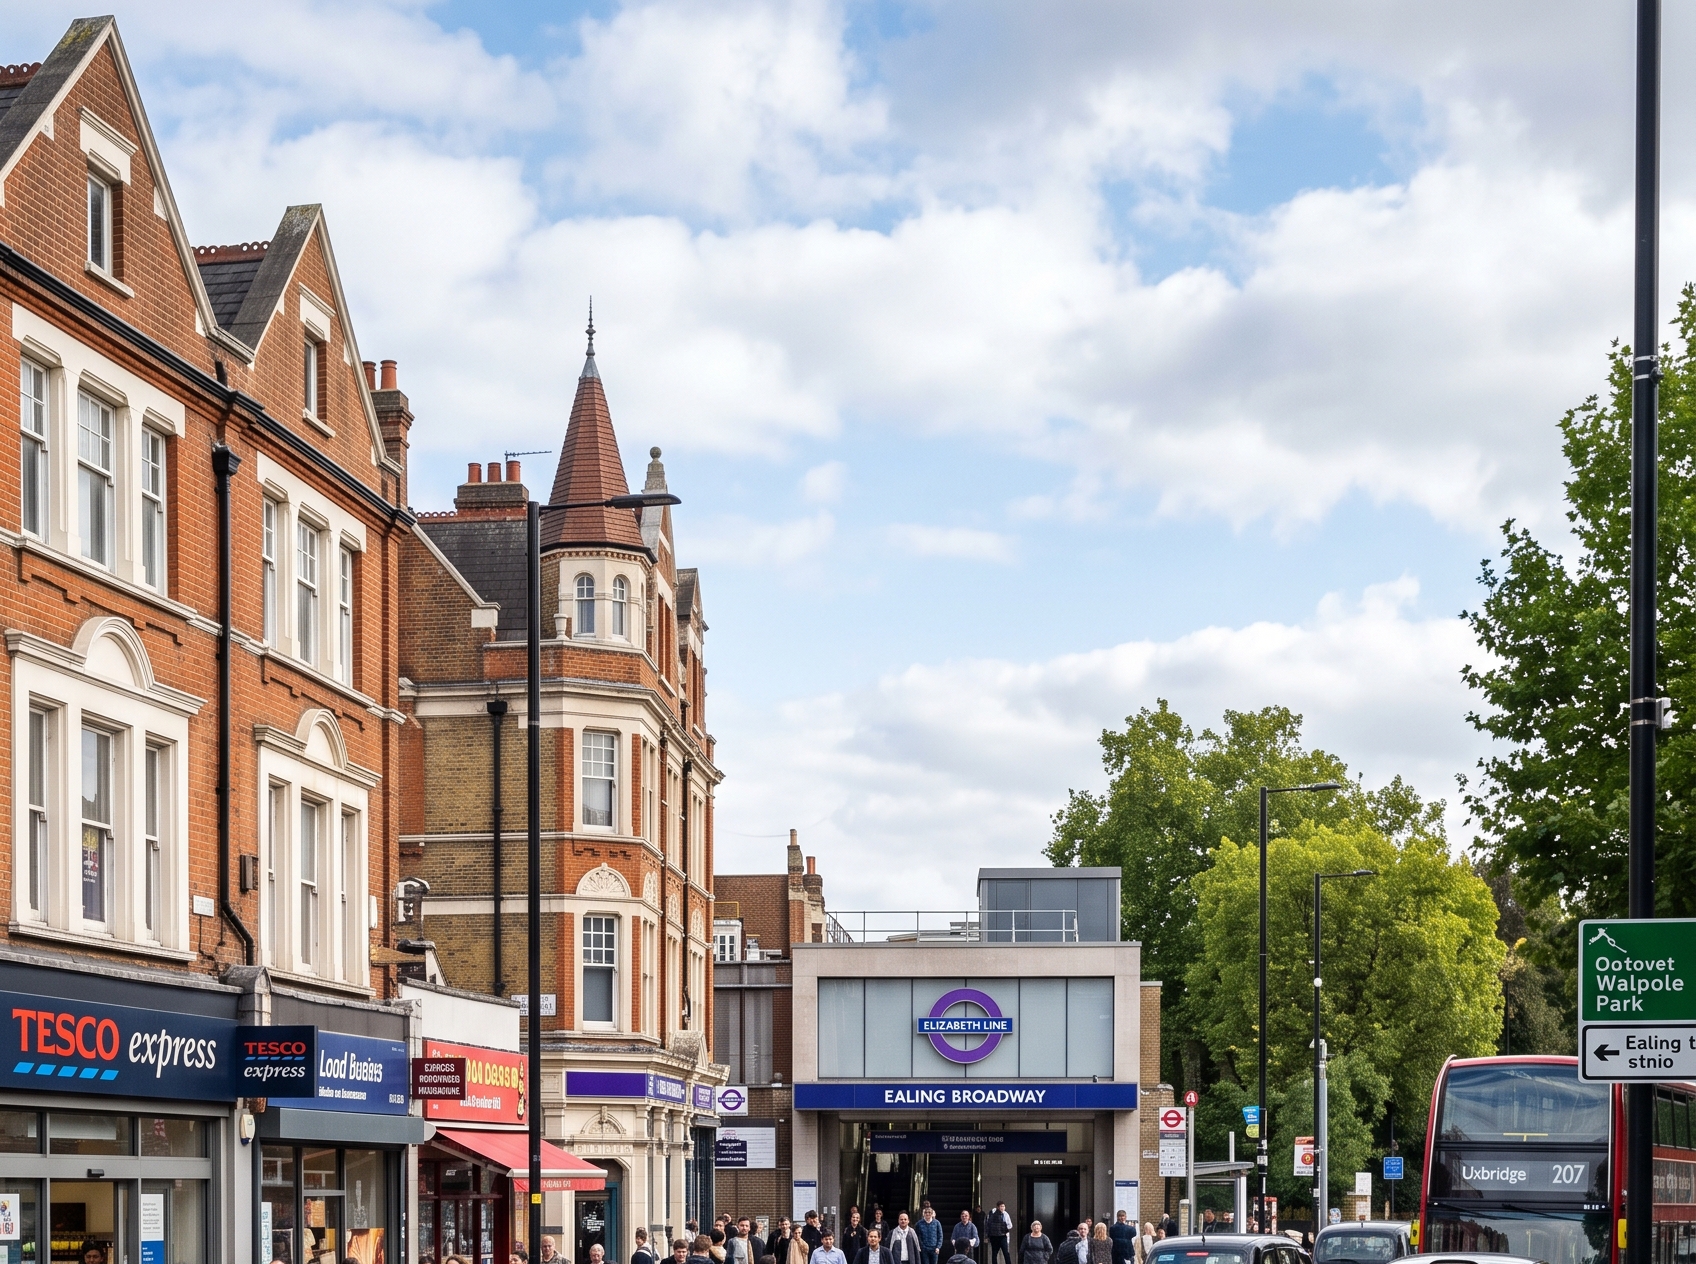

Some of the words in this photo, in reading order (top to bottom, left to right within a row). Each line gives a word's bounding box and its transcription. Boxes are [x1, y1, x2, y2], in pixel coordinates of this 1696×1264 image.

[1595, 956, 1675, 971] Ootovet
[1596, 974, 1684, 994] Walpole
[1596, 995, 1644, 1011] Park
[923, 1021, 981, 1030] ELIZABETH
[984, 1021, 1007, 1030] LINE
[12, 1008, 120, 1061] TESCO
[129, 1028, 217, 1078] express
[244, 1042, 306, 1055] TESCO
[1626, 1035, 1681, 1053] Ealing
[1628, 1053, 1674, 1068] stnio
[244, 1065, 306, 1081] express
[885, 1090, 945, 1103] EALING
[952, 1090, 1046, 1103] BROADWAY
[1462, 1166, 1527, 1184] Uxbridge
[1552, 1164, 1585, 1184] 207
